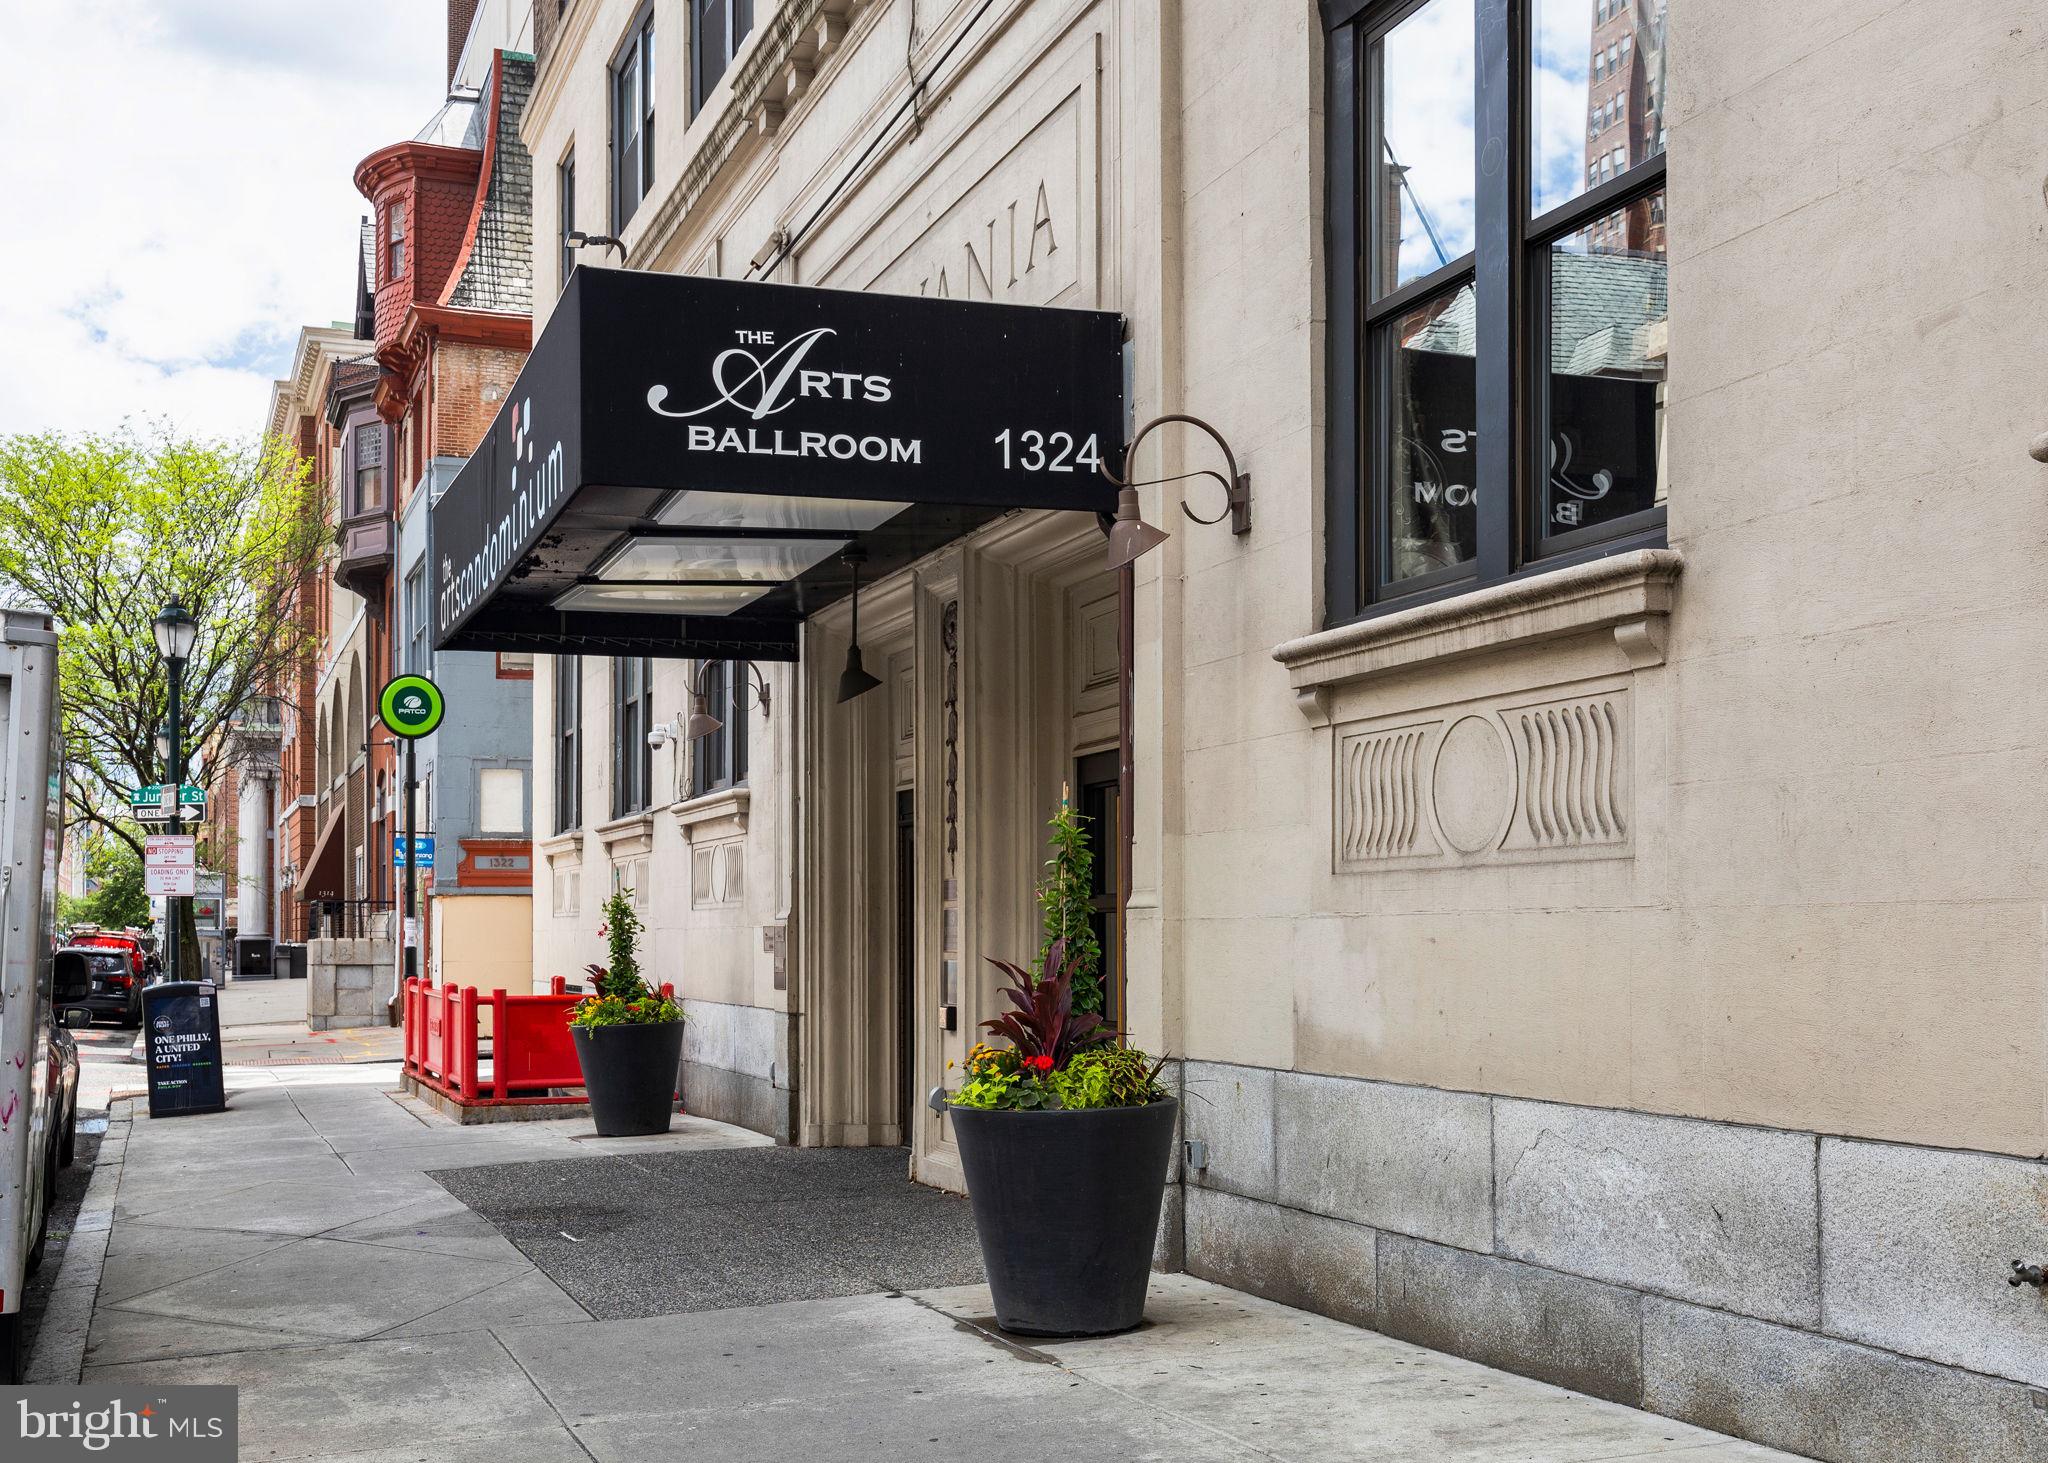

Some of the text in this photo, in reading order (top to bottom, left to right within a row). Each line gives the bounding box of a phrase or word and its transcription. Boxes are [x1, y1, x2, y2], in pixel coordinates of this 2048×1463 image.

[735, 330, 774, 345] THE
[647, 328, 892, 419] ARTS
[687, 425, 922, 464] BALLROOM
[995, 429, 1101, 473] 1324
[442, 552, 452, 582] the
[191, 791, 204, 801] St
[140, 809, 160, 817] ONE
[490, 858, 514, 868] 1322
[155, 1033, 211, 1044] ONE PHILLY,
[164, 1043, 200, 1052] UNITED
[156, 1054, 182, 1063] CITY!
